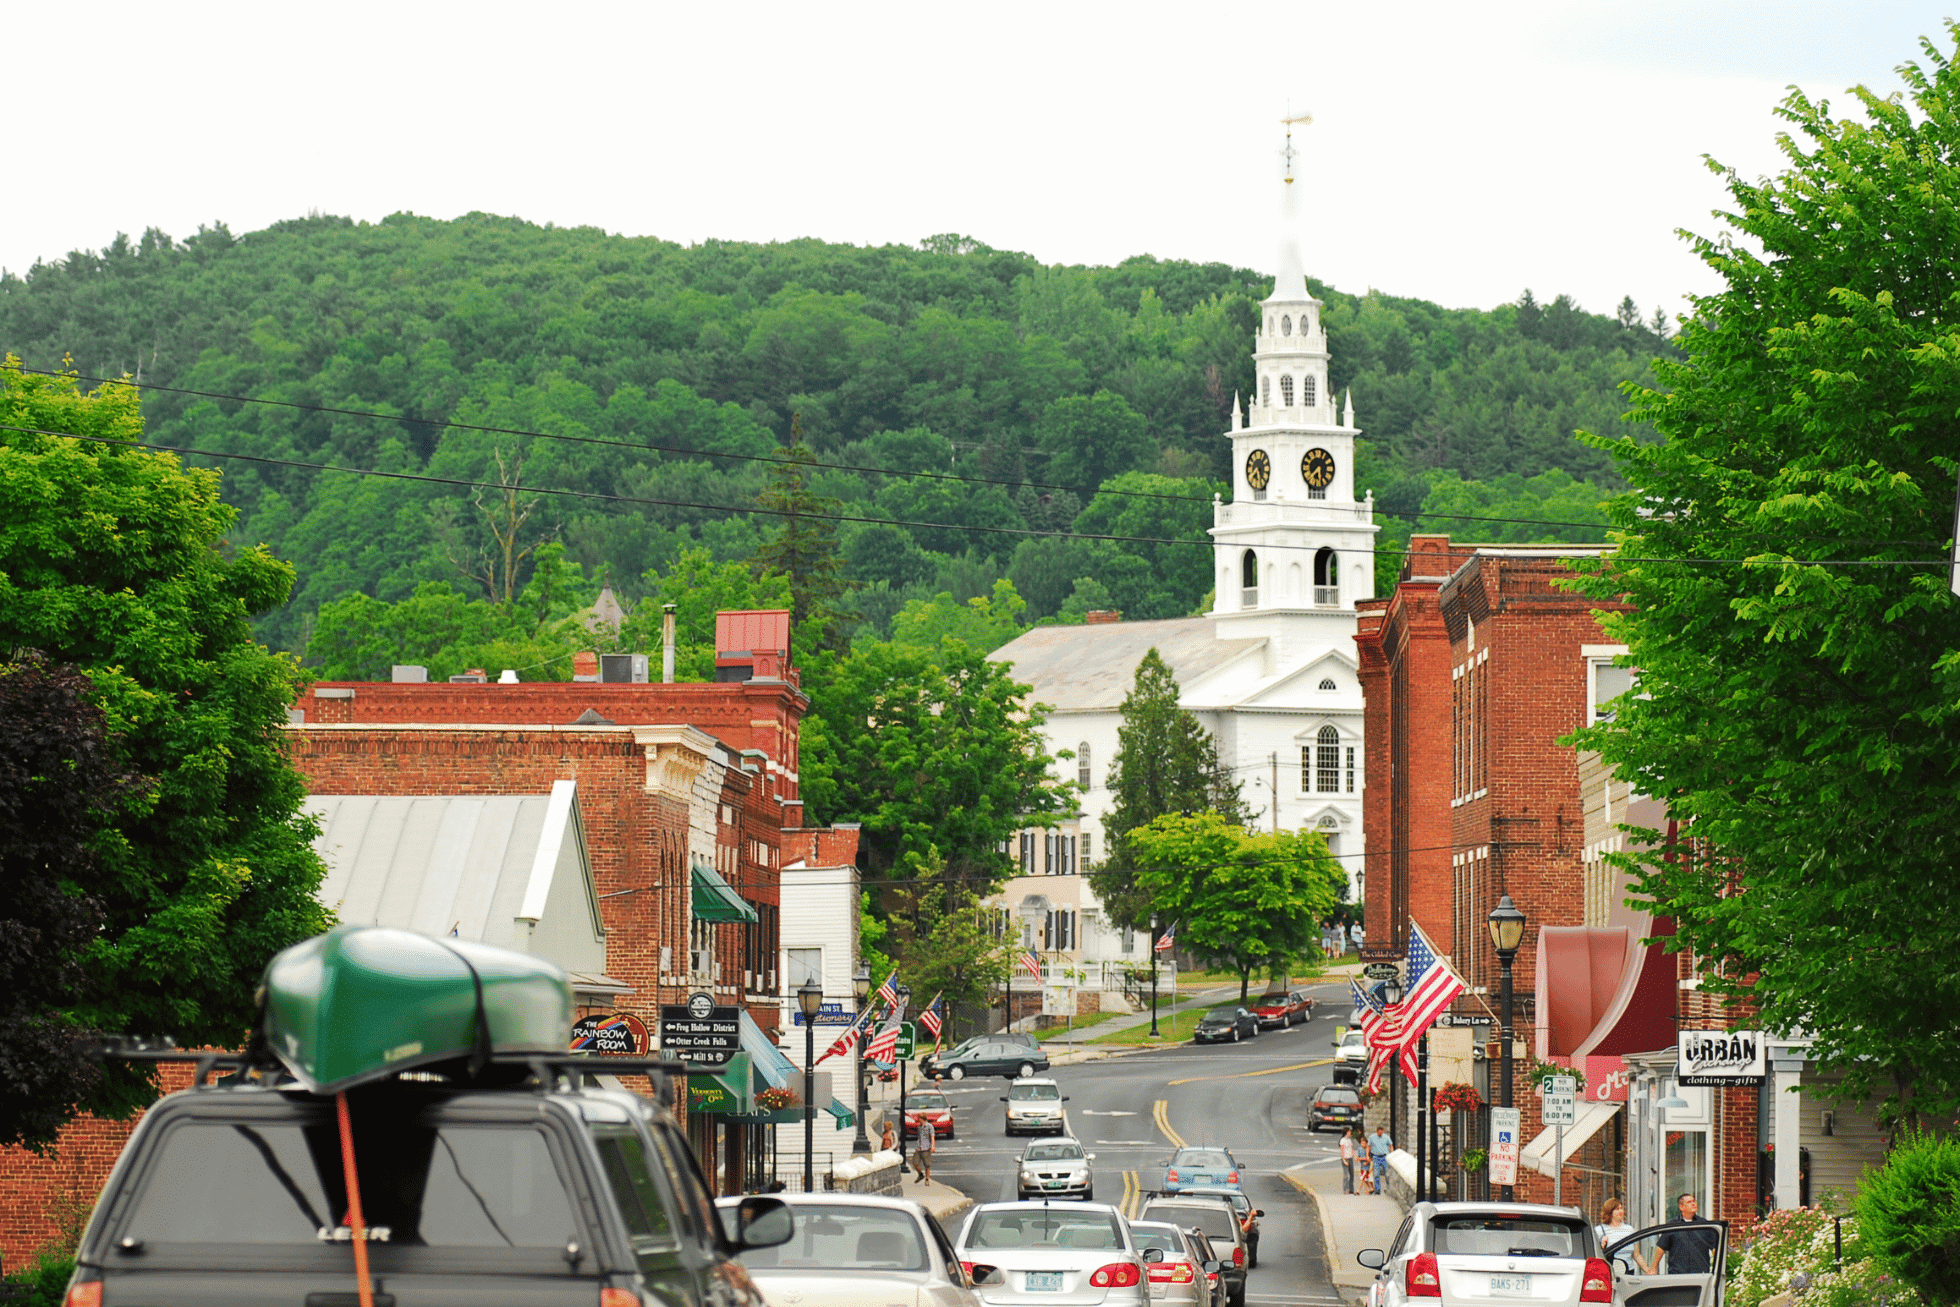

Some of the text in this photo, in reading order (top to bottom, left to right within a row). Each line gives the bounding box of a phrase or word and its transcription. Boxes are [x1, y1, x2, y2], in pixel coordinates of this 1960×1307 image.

[1452, 1016, 1470, 1026] Bakery
[676, 1023, 736, 1033] Frog Hollow District
[572, 1028, 627, 1039] RAINBOW
[596, 1038, 627, 1050] ROOM
[676, 1037, 727, 1046] Otter Creek Falls
[1685, 1033, 1756, 1061] URBAN
[693, 1053, 714, 1061] Mill St
[1690, 1053, 1752, 1073] Exchange
[1545, 1080, 1552, 1092] 2
[1493, 1111, 1518, 1119] RESERVED
[1500, 1144, 1510, 1152] NO
[1491, 1153, 1516, 1163] PARKING
[316, 1226, 391, 1241] LER
